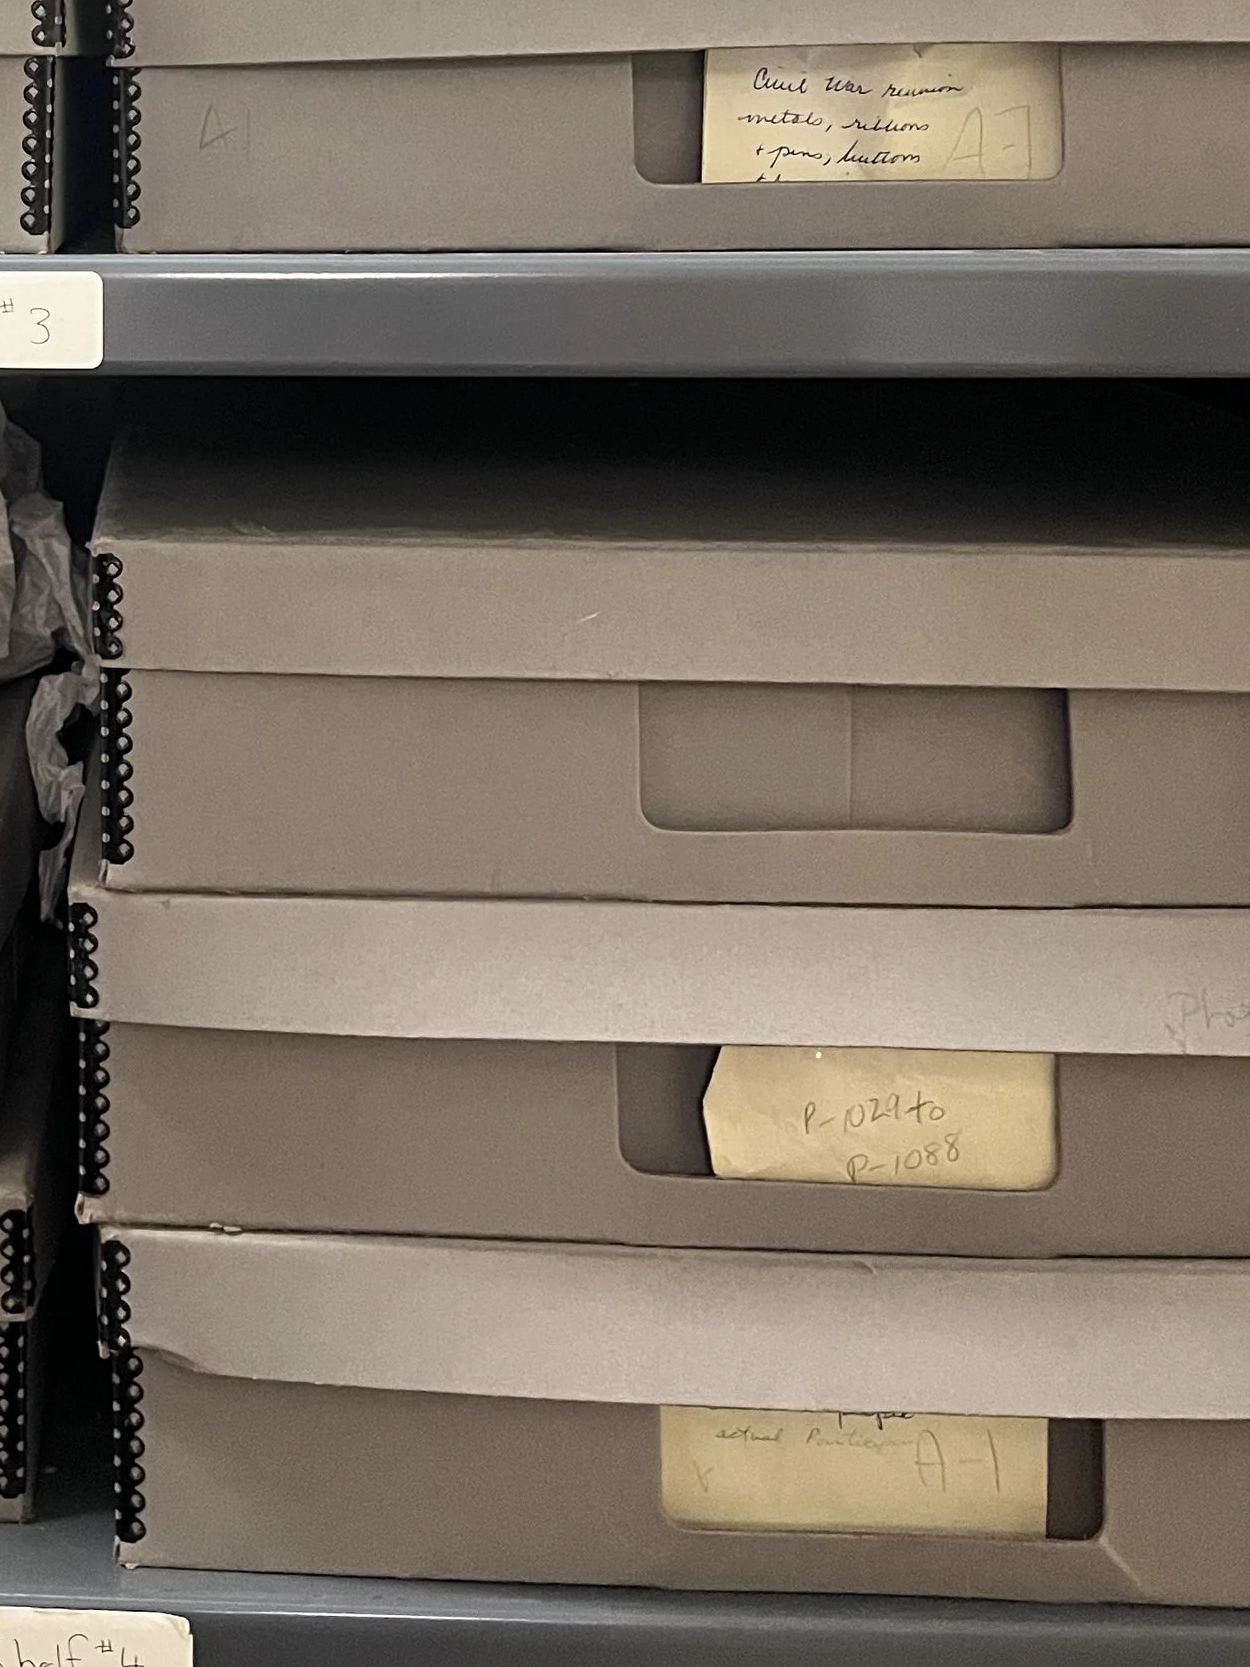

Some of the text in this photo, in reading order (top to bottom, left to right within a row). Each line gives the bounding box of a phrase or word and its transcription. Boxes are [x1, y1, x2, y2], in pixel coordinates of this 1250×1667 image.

[753, 67, 807, 94] Civil
[825, 76, 873, 95] War
[907, 1090, 946, 1123] to
[846, 1133, 962, 1183] P-1088
